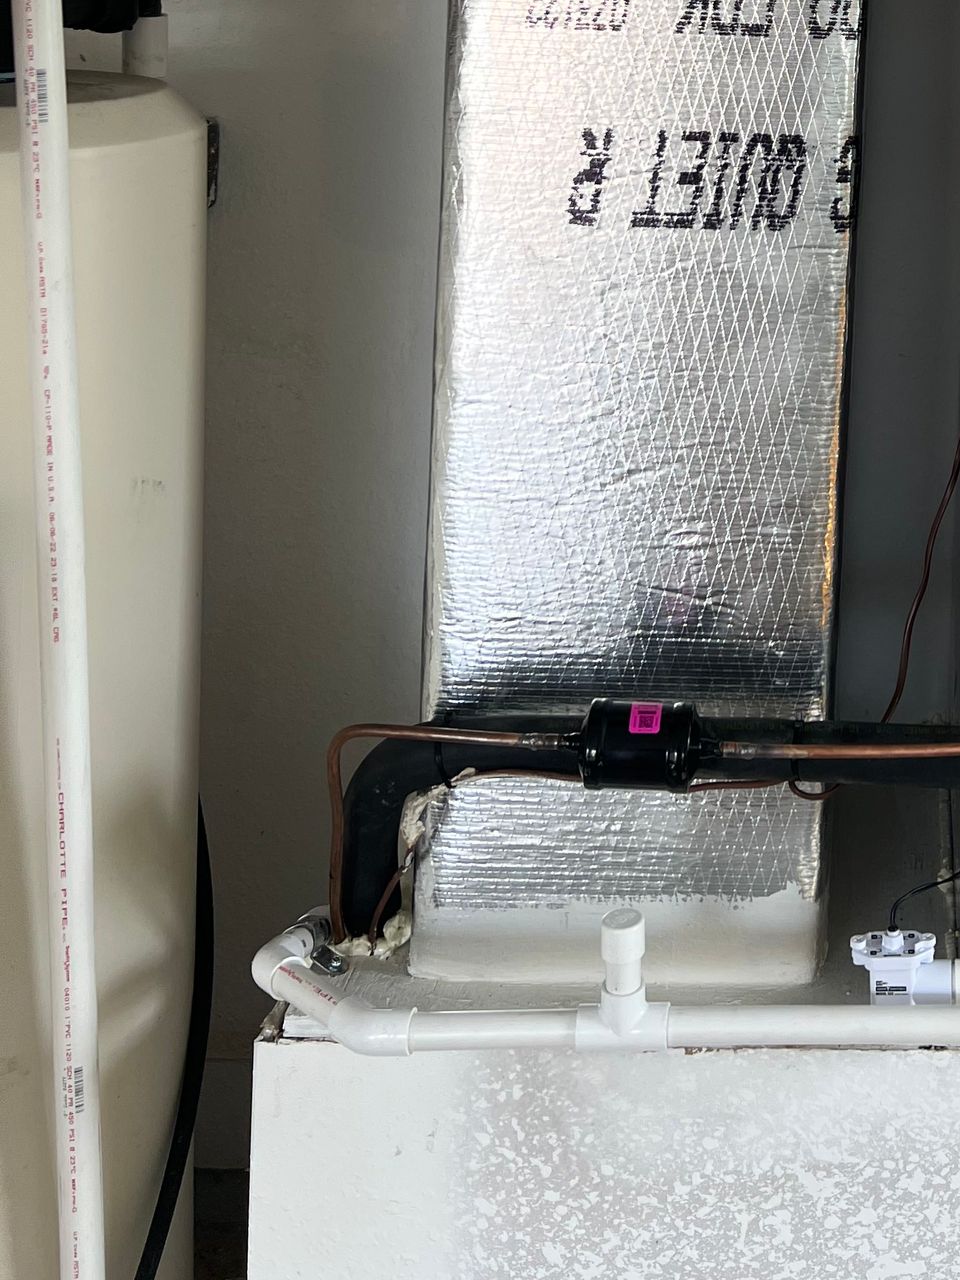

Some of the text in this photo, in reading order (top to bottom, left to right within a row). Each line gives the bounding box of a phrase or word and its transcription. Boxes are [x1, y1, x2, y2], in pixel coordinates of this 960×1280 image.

[631, 130, 807, 232] QUIET
[57, 792, 68, 878] CHARLOTTE
[60, 888, 69, 926] PIPE
[67, 1084, 74, 1093] 40
